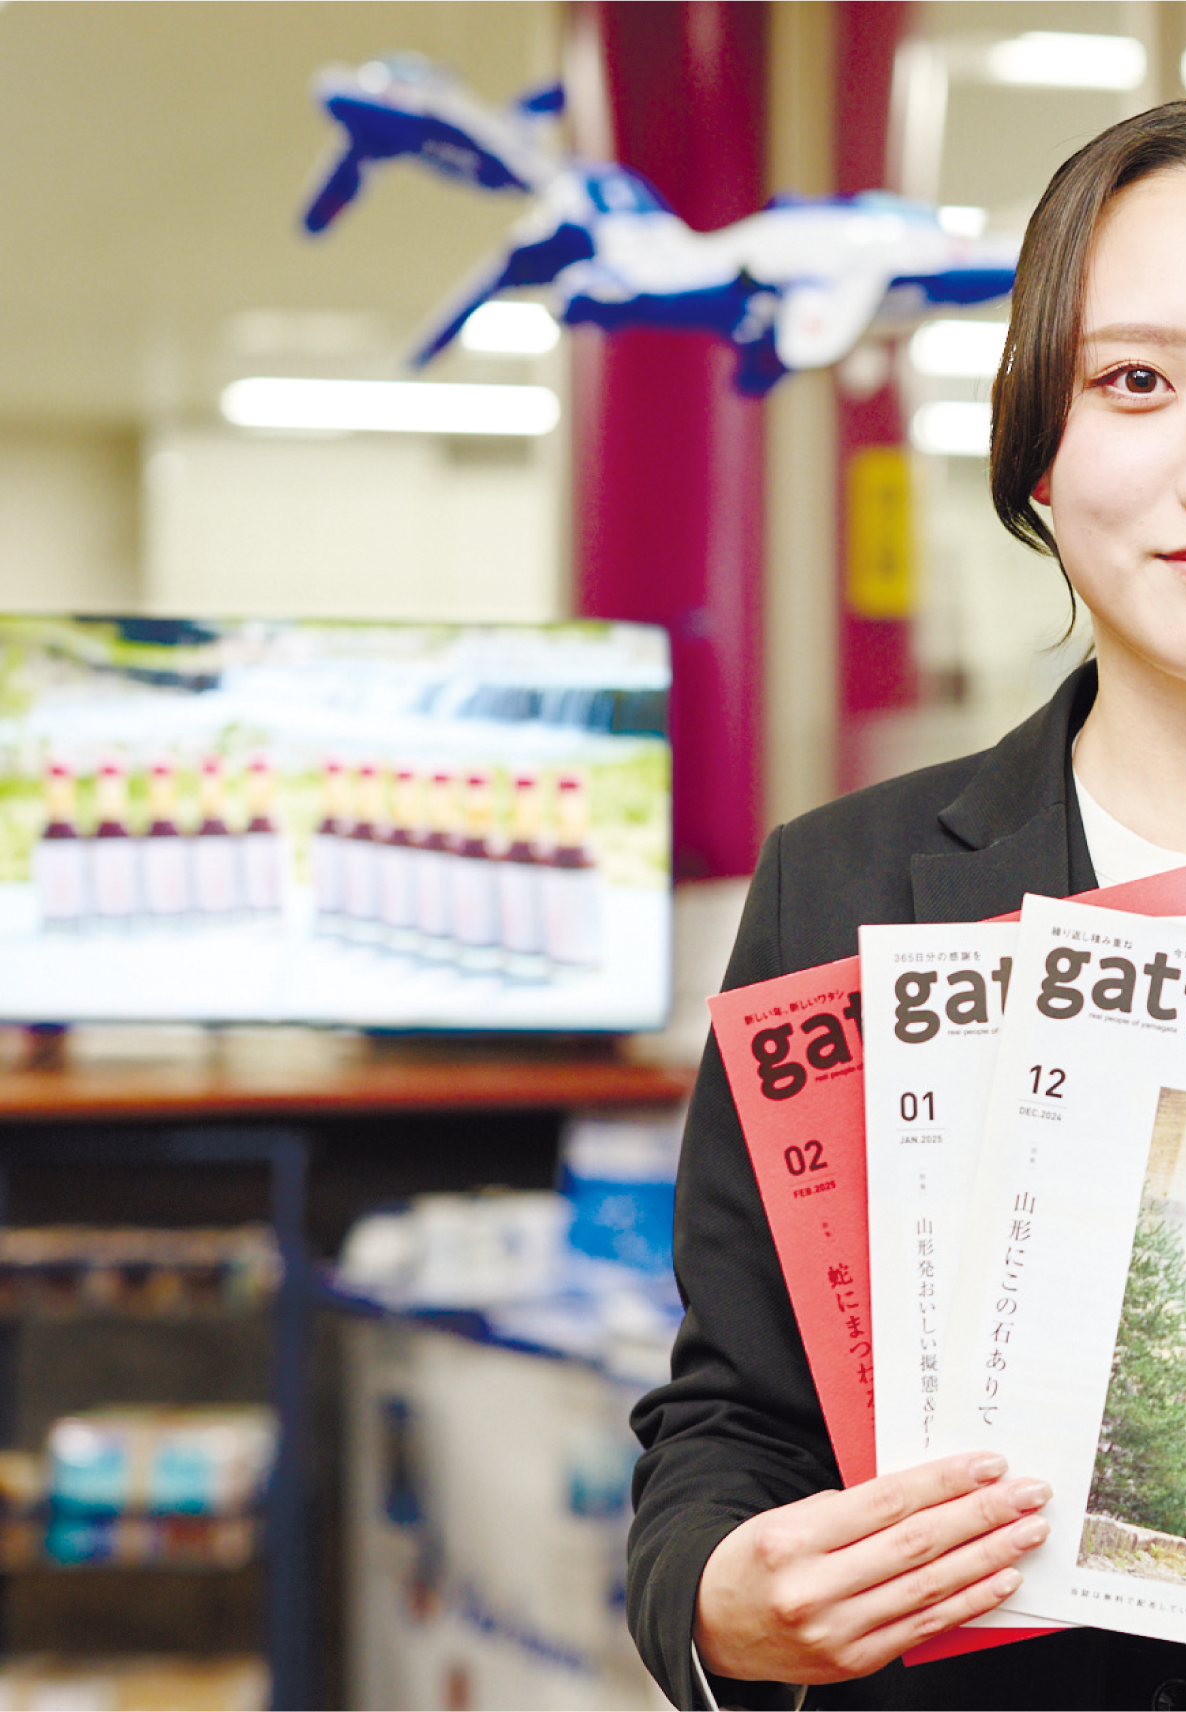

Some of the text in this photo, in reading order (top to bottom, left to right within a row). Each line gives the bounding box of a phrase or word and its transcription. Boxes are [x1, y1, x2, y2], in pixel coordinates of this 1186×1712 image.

[1104, 1014, 1130, 1027] people
[1141, 1021, 1177, 1034] yamagata
[1029, 1065, 1067, 1099] 12
[900, 1091, 935, 1122] 01
[1019, 1106, 1062, 1122] DEC.2024
[900, 1135, 943, 1145] JAN.2025
[784, 1139, 828, 1176] 02
[793, 1180, 836, 1199] FEB.2025
[978, 1191, 1036, 1426] 山形にこの石ありて
